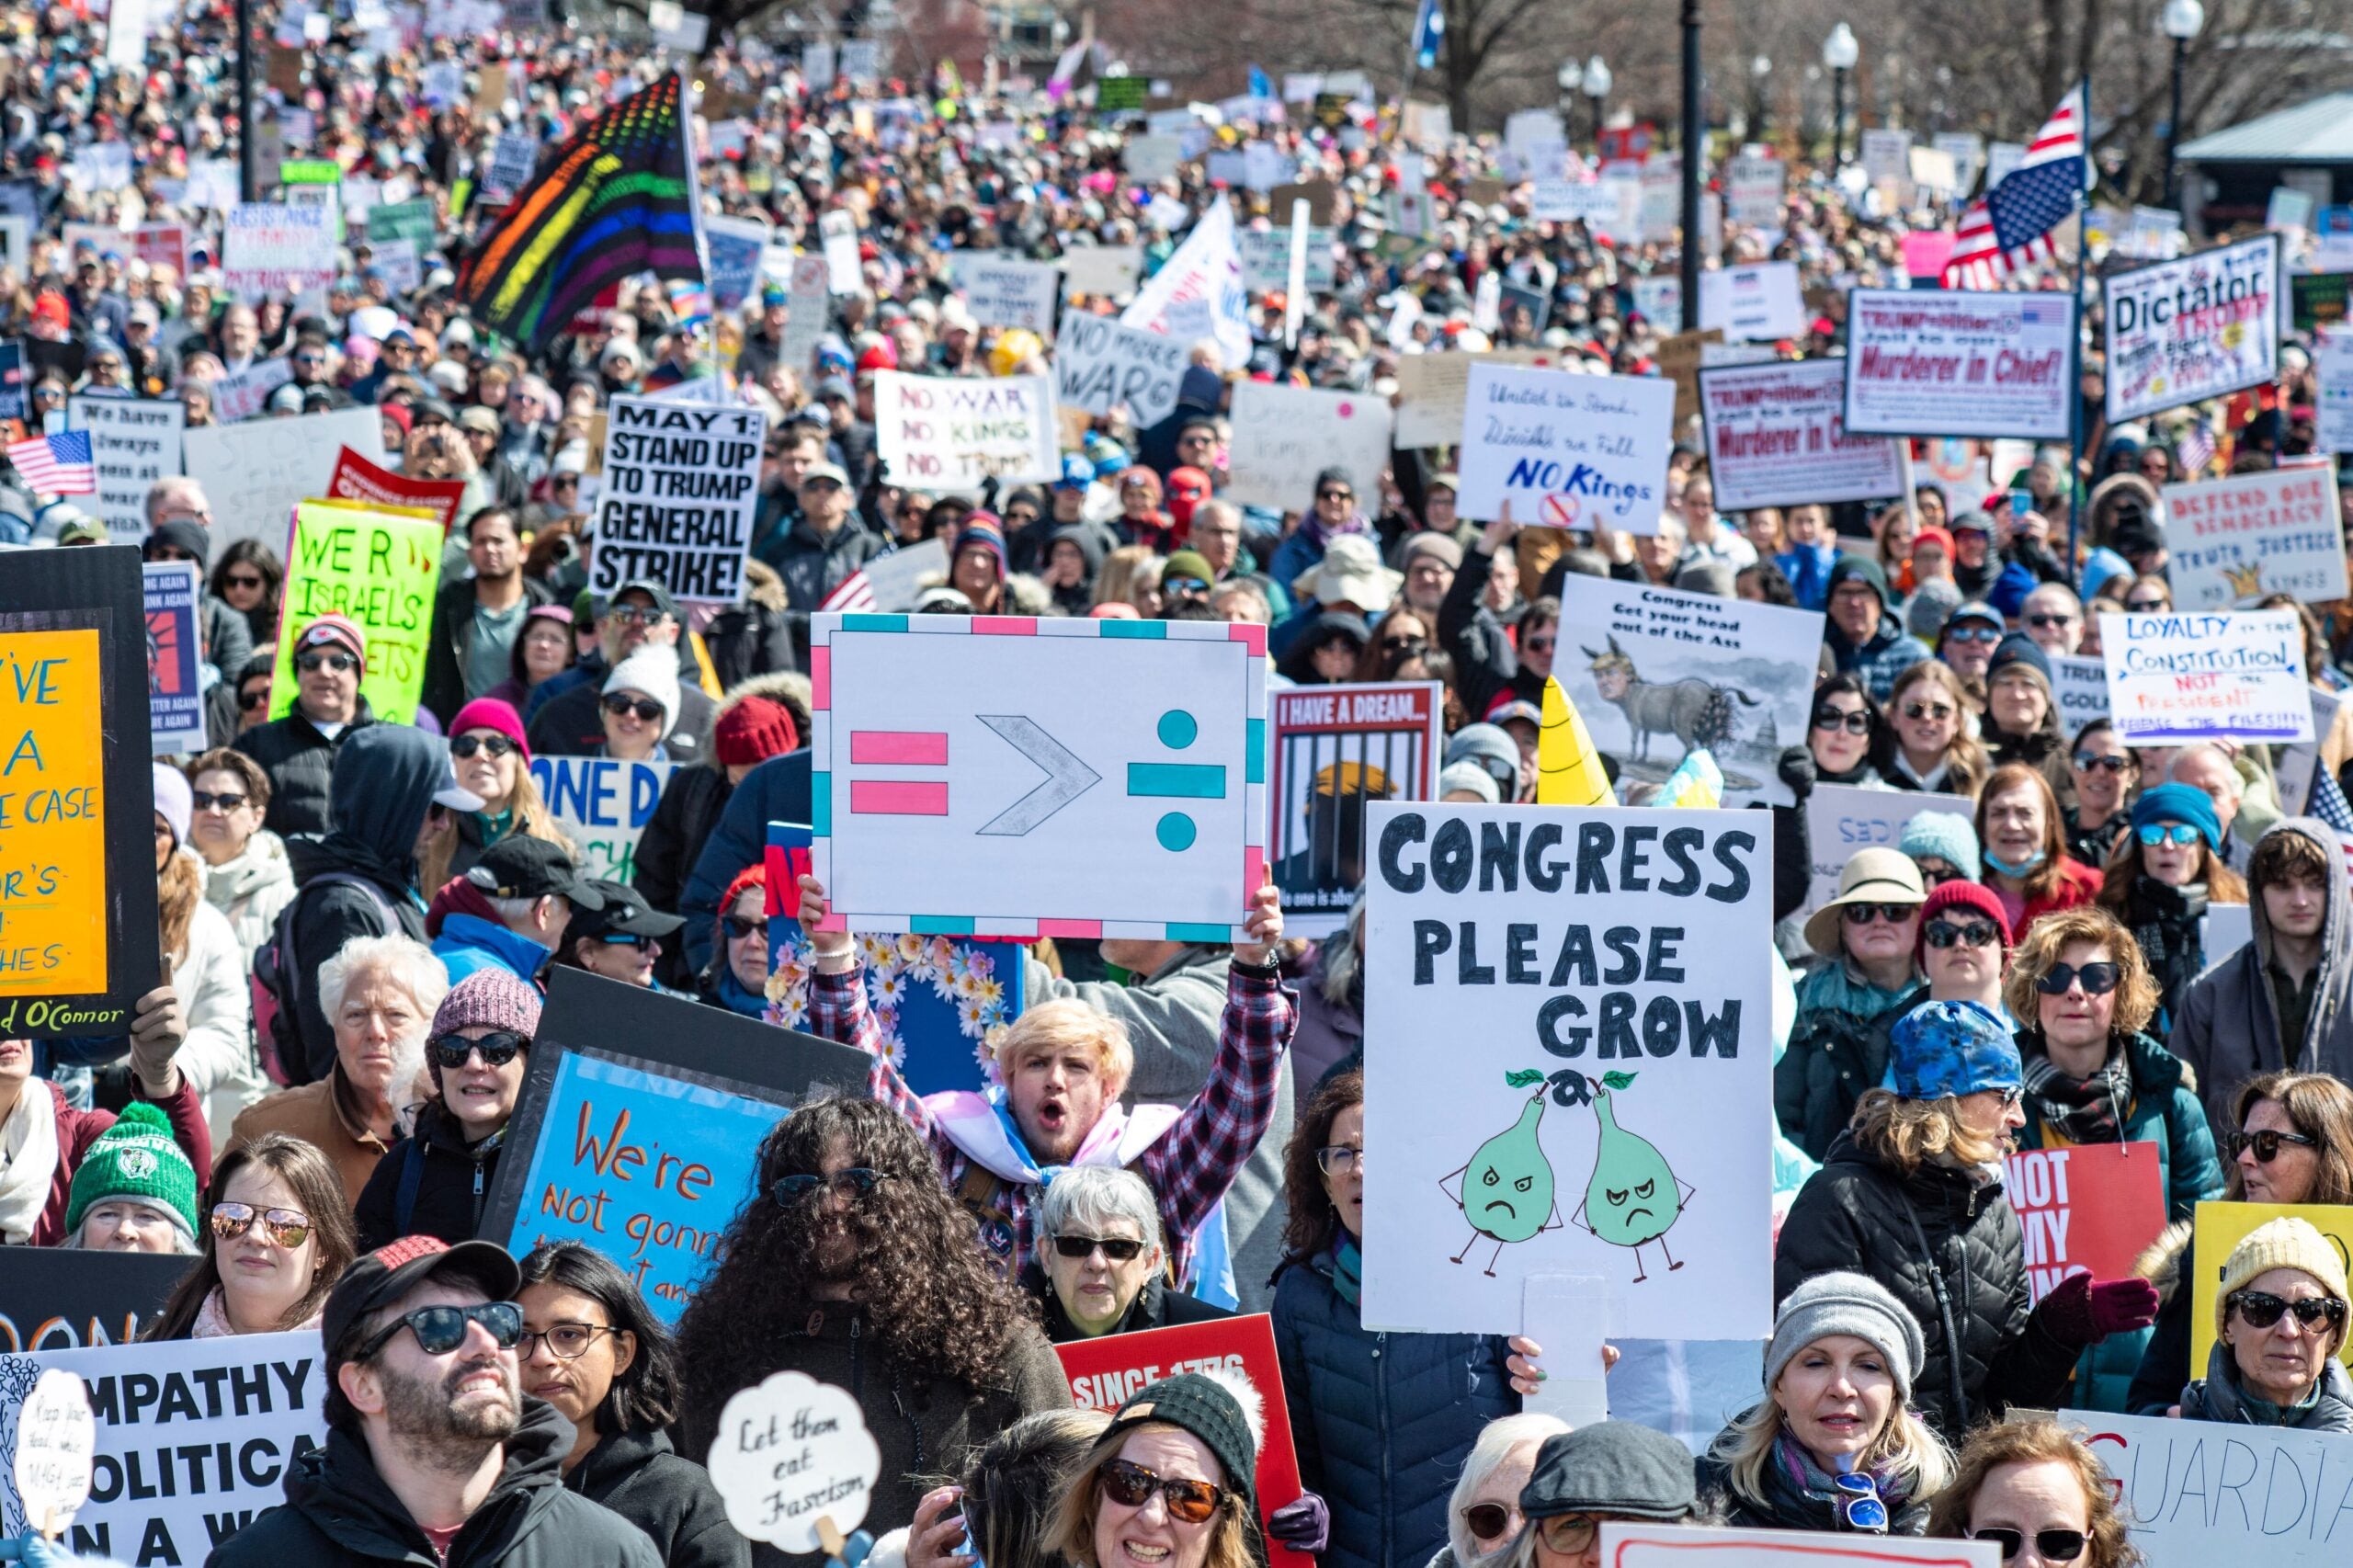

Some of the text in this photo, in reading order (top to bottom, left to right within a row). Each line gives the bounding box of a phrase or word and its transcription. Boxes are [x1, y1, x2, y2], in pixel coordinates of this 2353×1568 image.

[2115, 271, 2265, 335] Dictator
[1061, 318, 1111, 358] NO
[1859, 346, 2063, 386] Murderer in Chief!
[119, 404, 170, 426] have
[900, 384, 1028, 414] NO WAR
[617, 404, 758, 438] MAY 1:
[901, 419, 1029, 445] NO KINGS
[1717, 419, 1802, 459] Murderer
[97, 461, 134, 478] een
[611, 431, 757, 471] STAND UP
[906, 453, 942, 476] NO
[608, 464, 753, 501] TO TRUMP
[1506, 457, 1653, 517] NO Kings
[2171, 488, 2268, 520] DEFEND
[2193, 501, 2325, 538] DEMOCRACY
[601, 500, 745, 548] GENERAL
[296, 518, 392, 576] WE R
[2256, 530, 2337, 557] JUSTICE
[159, 574, 188, 590] AGAIN
[595, 544, 744, 597] STRIKE!
[164, 592, 192, 608] AGAIN
[295, 577, 424, 631] ISRAEL'S
[1612, 602, 1740, 633] Get your head
[1641, 590, 1722, 614] Congress
[1611, 619, 1742, 651] out of the Ass
[2127, 616, 2232, 641] LOYALTY
[2126, 642, 2287, 673] CONSTITUTION
[2137, 687, 2256, 711] PRESIDENT
[2174, 672, 2222, 693] NOT
[164, 714, 192, 729] AGAIN
[172, 696, 199, 711] AGAIN
[1279, 698, 1288, 727] I
[1290, 696, 1336, 726] HAVE
[1336, 694, 1351, 724] A
[3, 729, 46, 778] A
[24, 785, 99, 825] CASE
[1378, 812, 1757, 904] CONGRESS
[1293, 891, 1317, 908] one
[1317, 887, 1330, 907] is
[1413, 918, 1687, 987] PLEASE
[25, 996, 125, 1033] O'Connor
[1536, 991, 1743, 1060] GROW
[1547, 1067, 1594, 1108] a
[574, 1099, 715, 1201] We're
[2001, 1150, 2070, 1210] NOT
[540, 1182, 613, 1235] Not
[2017, 1208, 2071, 1267] MY
[83, 1358, 313, 1426] MPATHY
[1072, 1365, 1163, 1410] SINCE
[738, 1405, 840, 1454] Let them
[772, 1447, 814, 1482] eat
[759, 1474, 866, 1527] Fascism
